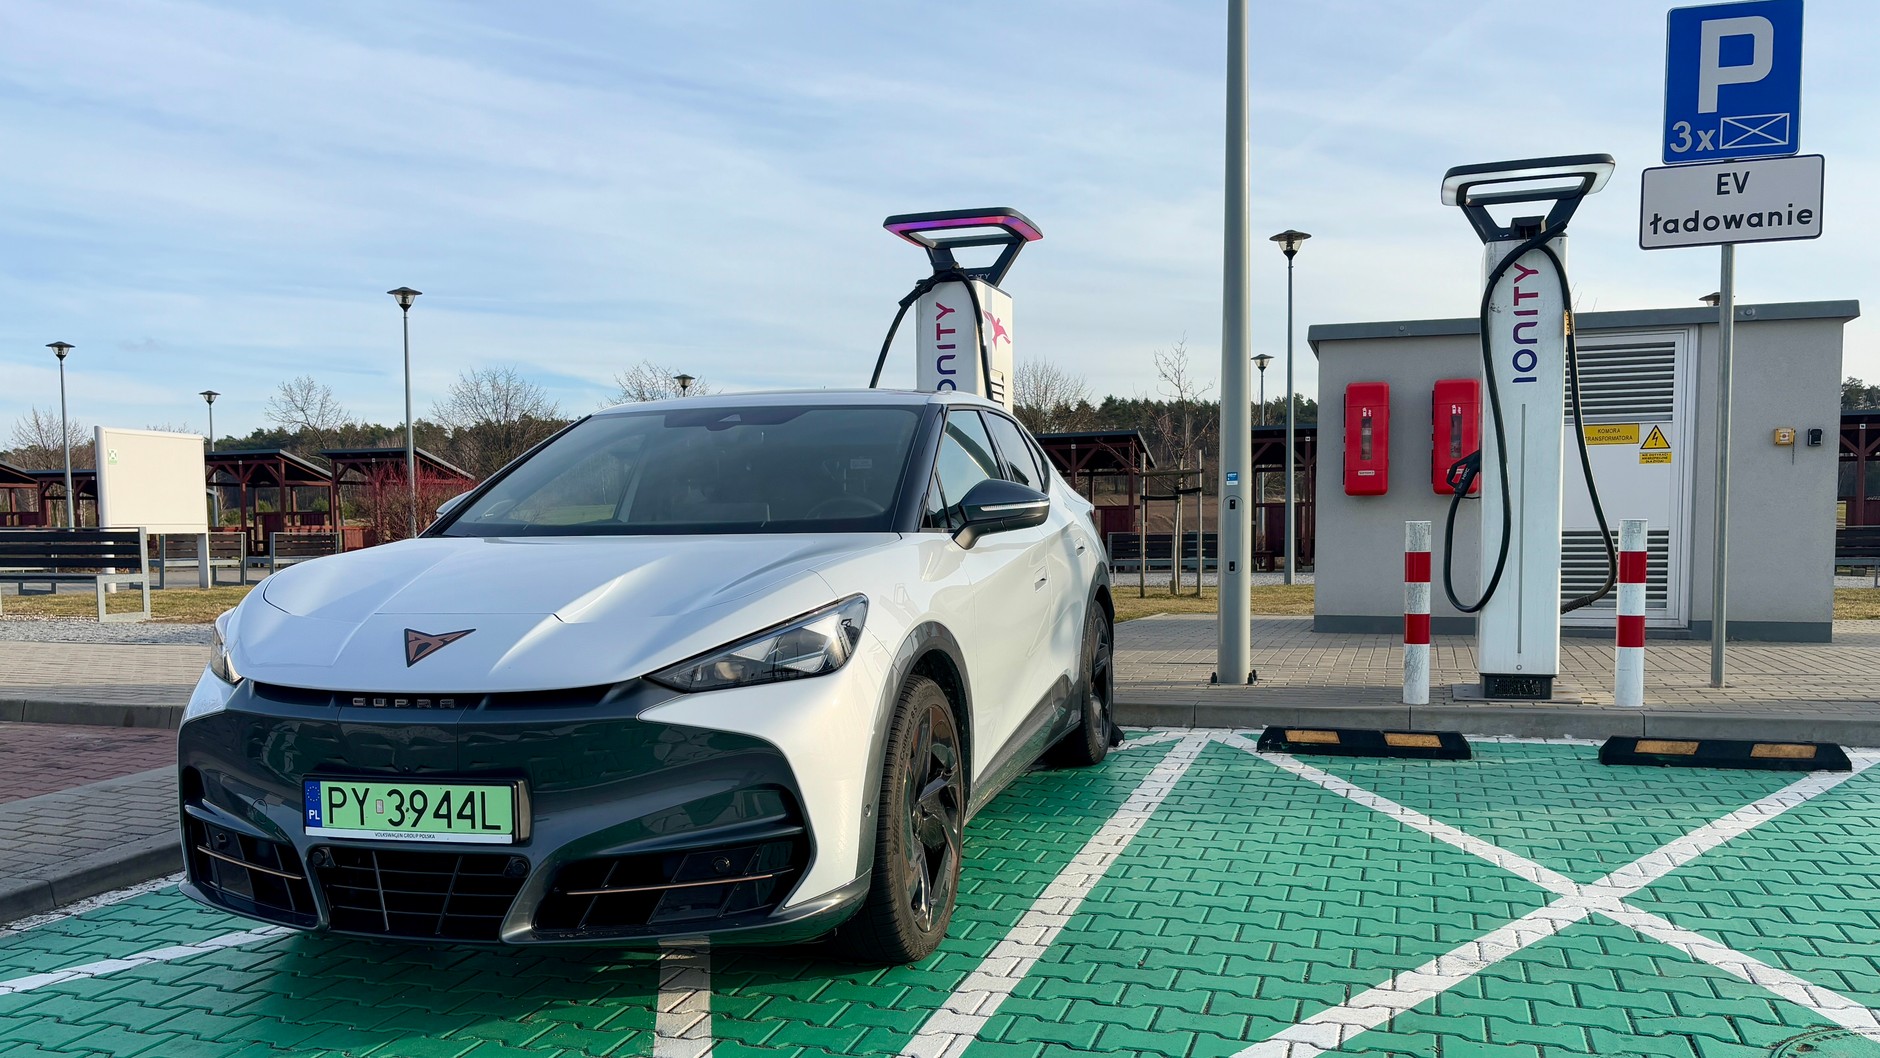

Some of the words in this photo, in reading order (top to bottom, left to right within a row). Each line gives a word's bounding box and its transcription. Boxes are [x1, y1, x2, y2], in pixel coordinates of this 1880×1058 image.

[1698, 15, 1774, 114] P
[1669, 120, 1716, 153] 3x
[1716, 171, 1750, 195] EV
[1650, 203, 1813, 235] ładowanie
[1512, 262, 1539, 383] IONITY
[936, 302, 956, 391] ONITY
[352, 697, 455, 708] CUPRA
[308, 809, 321, 820] PL
[328, 786, 370, 826] PY
[386, 788, 502, 831] 3944L
